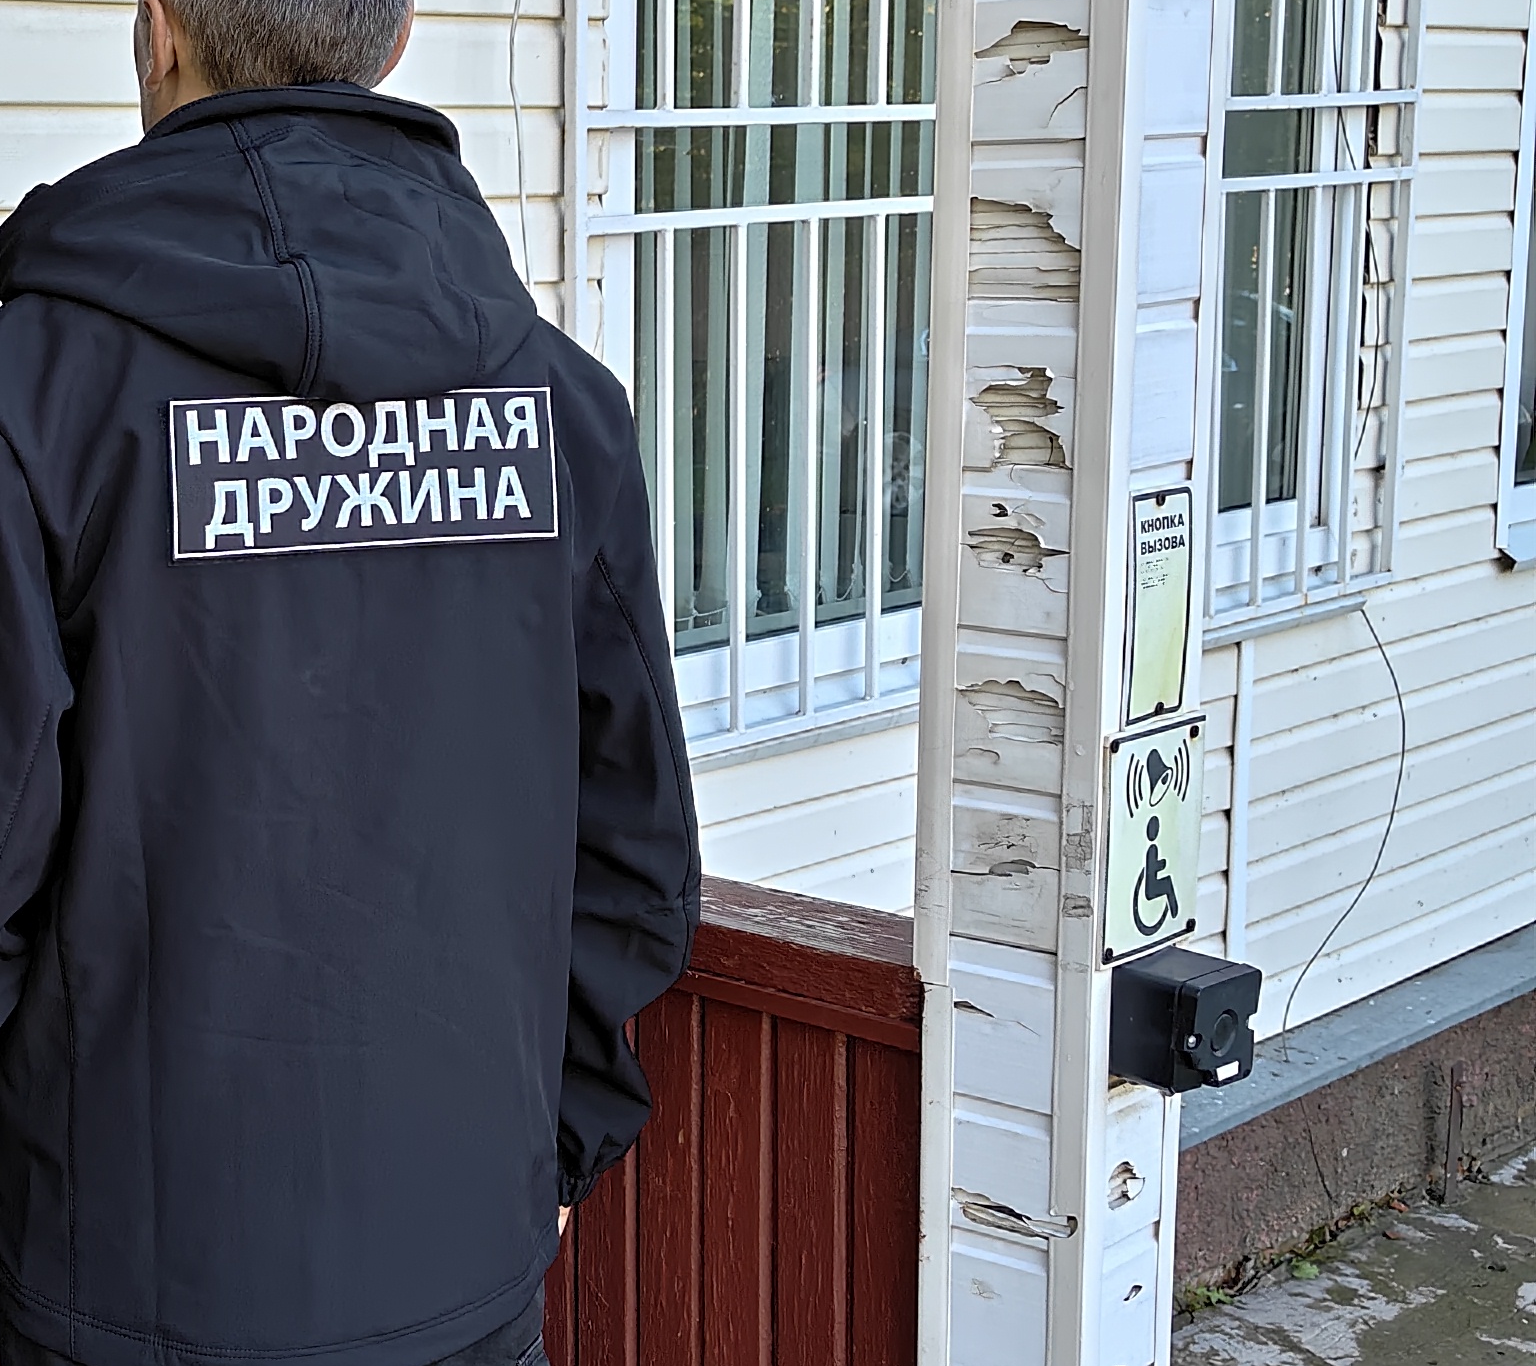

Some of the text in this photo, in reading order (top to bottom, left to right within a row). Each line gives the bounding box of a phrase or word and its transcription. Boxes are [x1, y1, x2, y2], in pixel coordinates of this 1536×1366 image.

[185, 396, 540, 468] НАРОДНАЯ
[205, 465, 532, 550] ДРУЖИНА
[1141, 513, 1185, 534] КНОПКА
[1141, 534, 1185, 555] ВЫЗОВА
